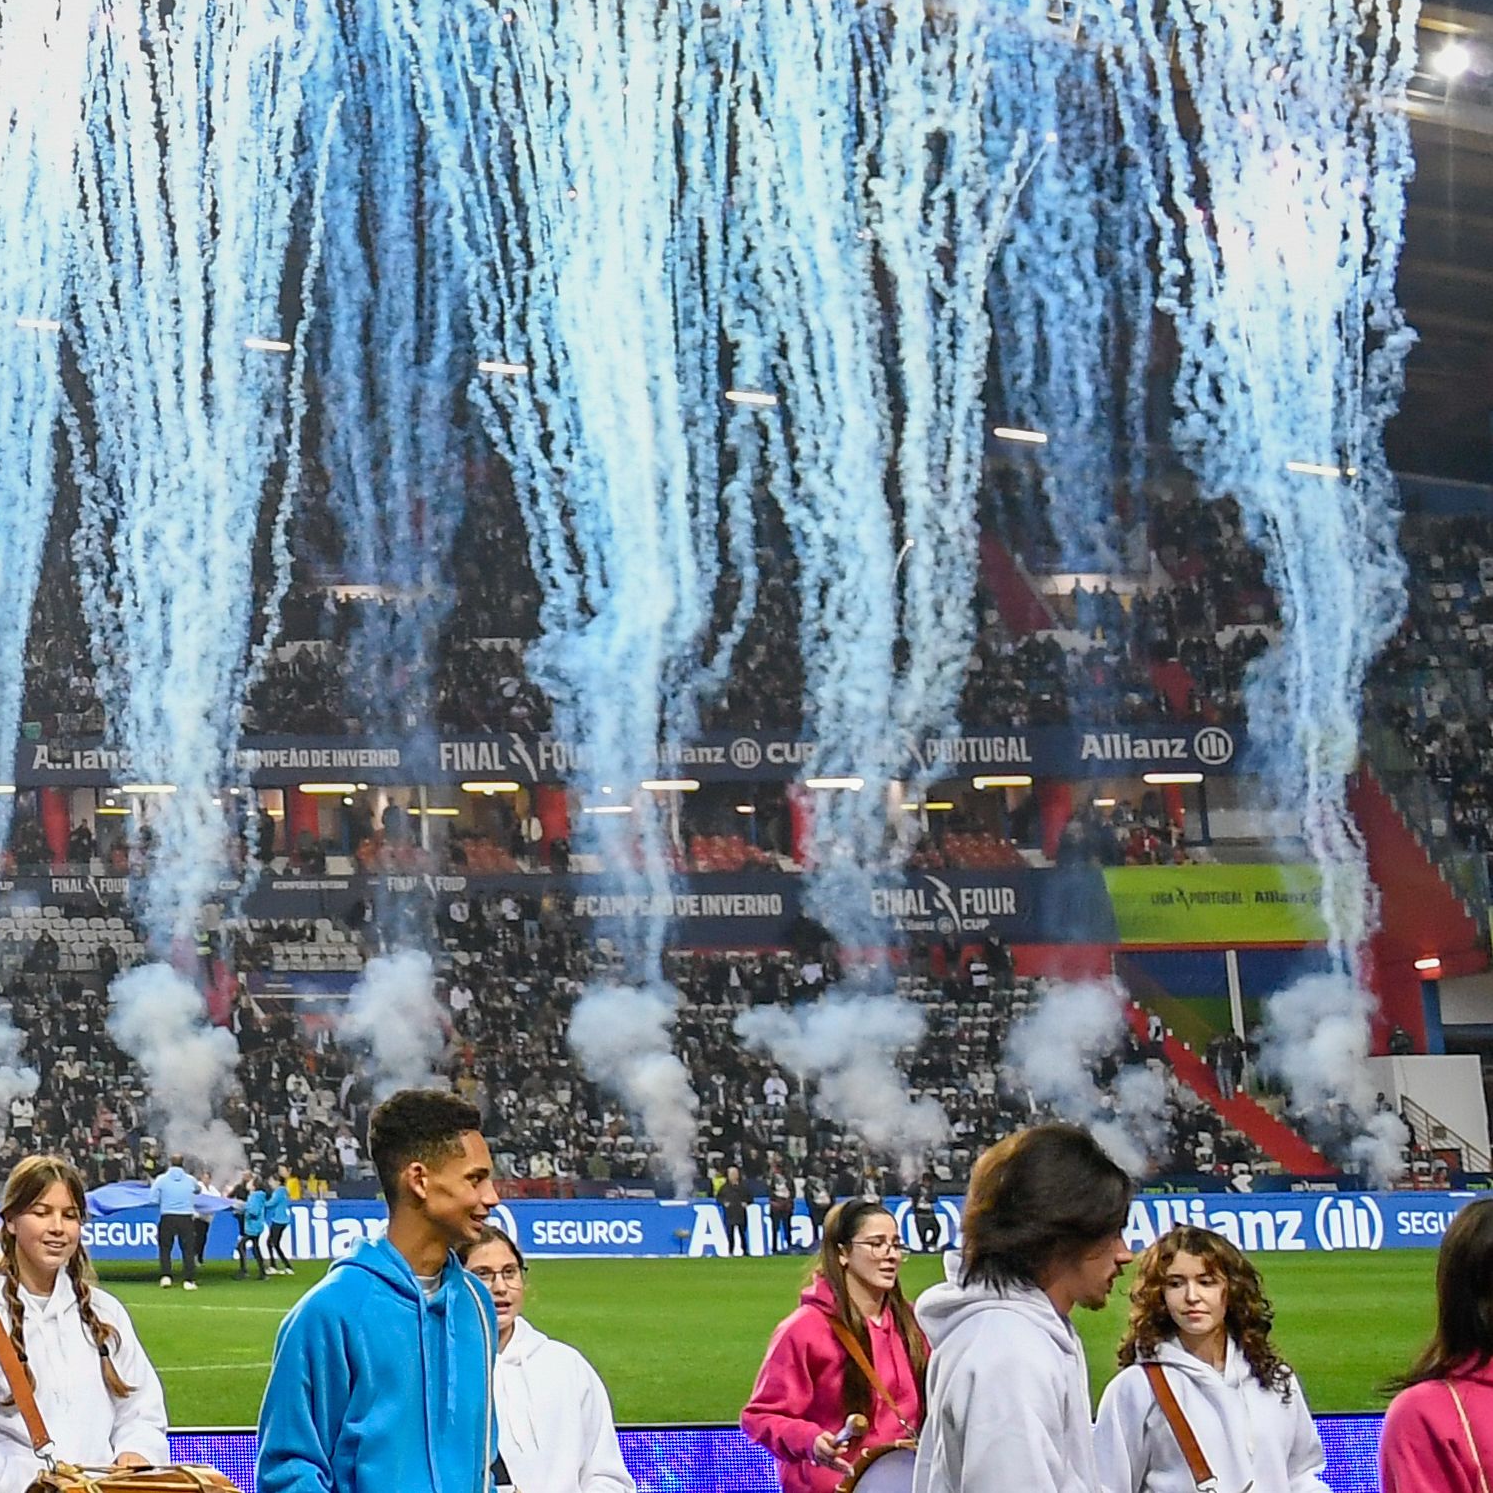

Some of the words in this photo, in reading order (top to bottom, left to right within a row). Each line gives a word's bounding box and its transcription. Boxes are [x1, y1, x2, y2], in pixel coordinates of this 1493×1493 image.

[439, 741, 507, 772] FINAL
[925, 736, 1033, 763] PORTUGAL
[1080, 733, 1189, 760] Allianz
[51, 878, 84, 894] FINAL
[99, 878, 130, 894] FOUR
[959, 887, 1017, 916] FOUR
[961, 918, 990, 931] CUP
[81, 1220, 159, 1247] SEGUR
[531, 1219, 644, 1245] SEGUROS
[1124, 1198, 1306, 1252] Allianz
[1397, 1210, 1450, 1235] SEGU
